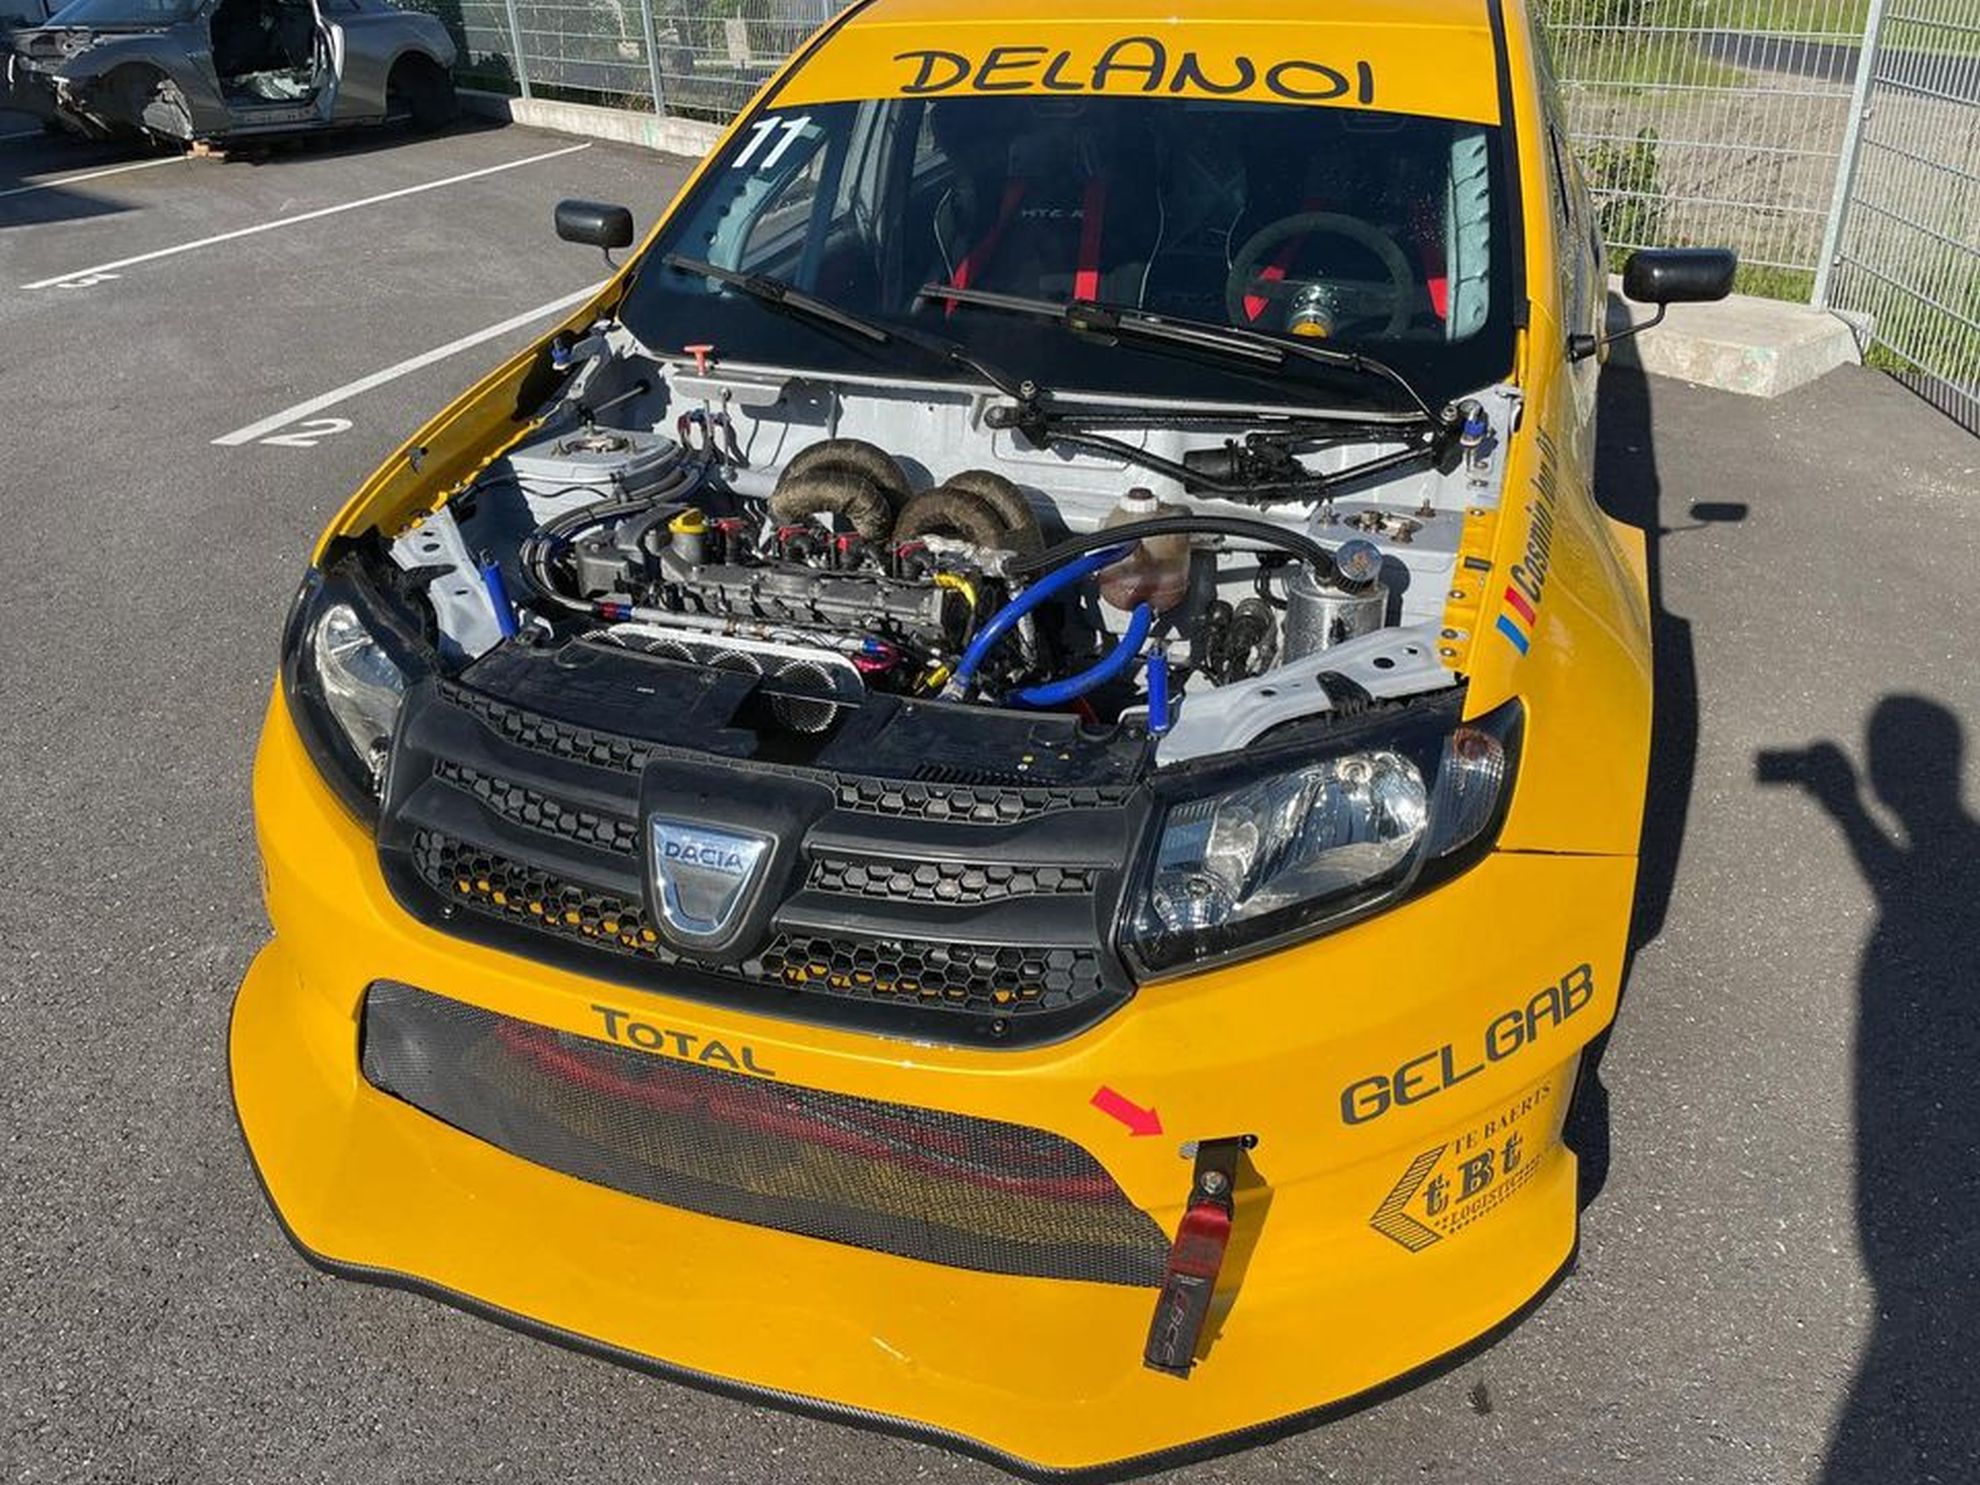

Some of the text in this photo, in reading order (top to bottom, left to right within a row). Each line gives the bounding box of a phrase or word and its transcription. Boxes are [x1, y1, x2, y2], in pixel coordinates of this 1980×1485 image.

[893, 36, 1374, 105] DELANOI
[731, 115, 812, 171] 11
[259, 417, 353, 447] 2
[1510, 499, 1554, 603] Cosmin
[664, 841, 744, 869] DACIA
[590, 1003, 776, 1077] TOTAL
[1341, 963, 1594, 1126] GELGAB
[1452, 1130, 1478, 1155] TE
